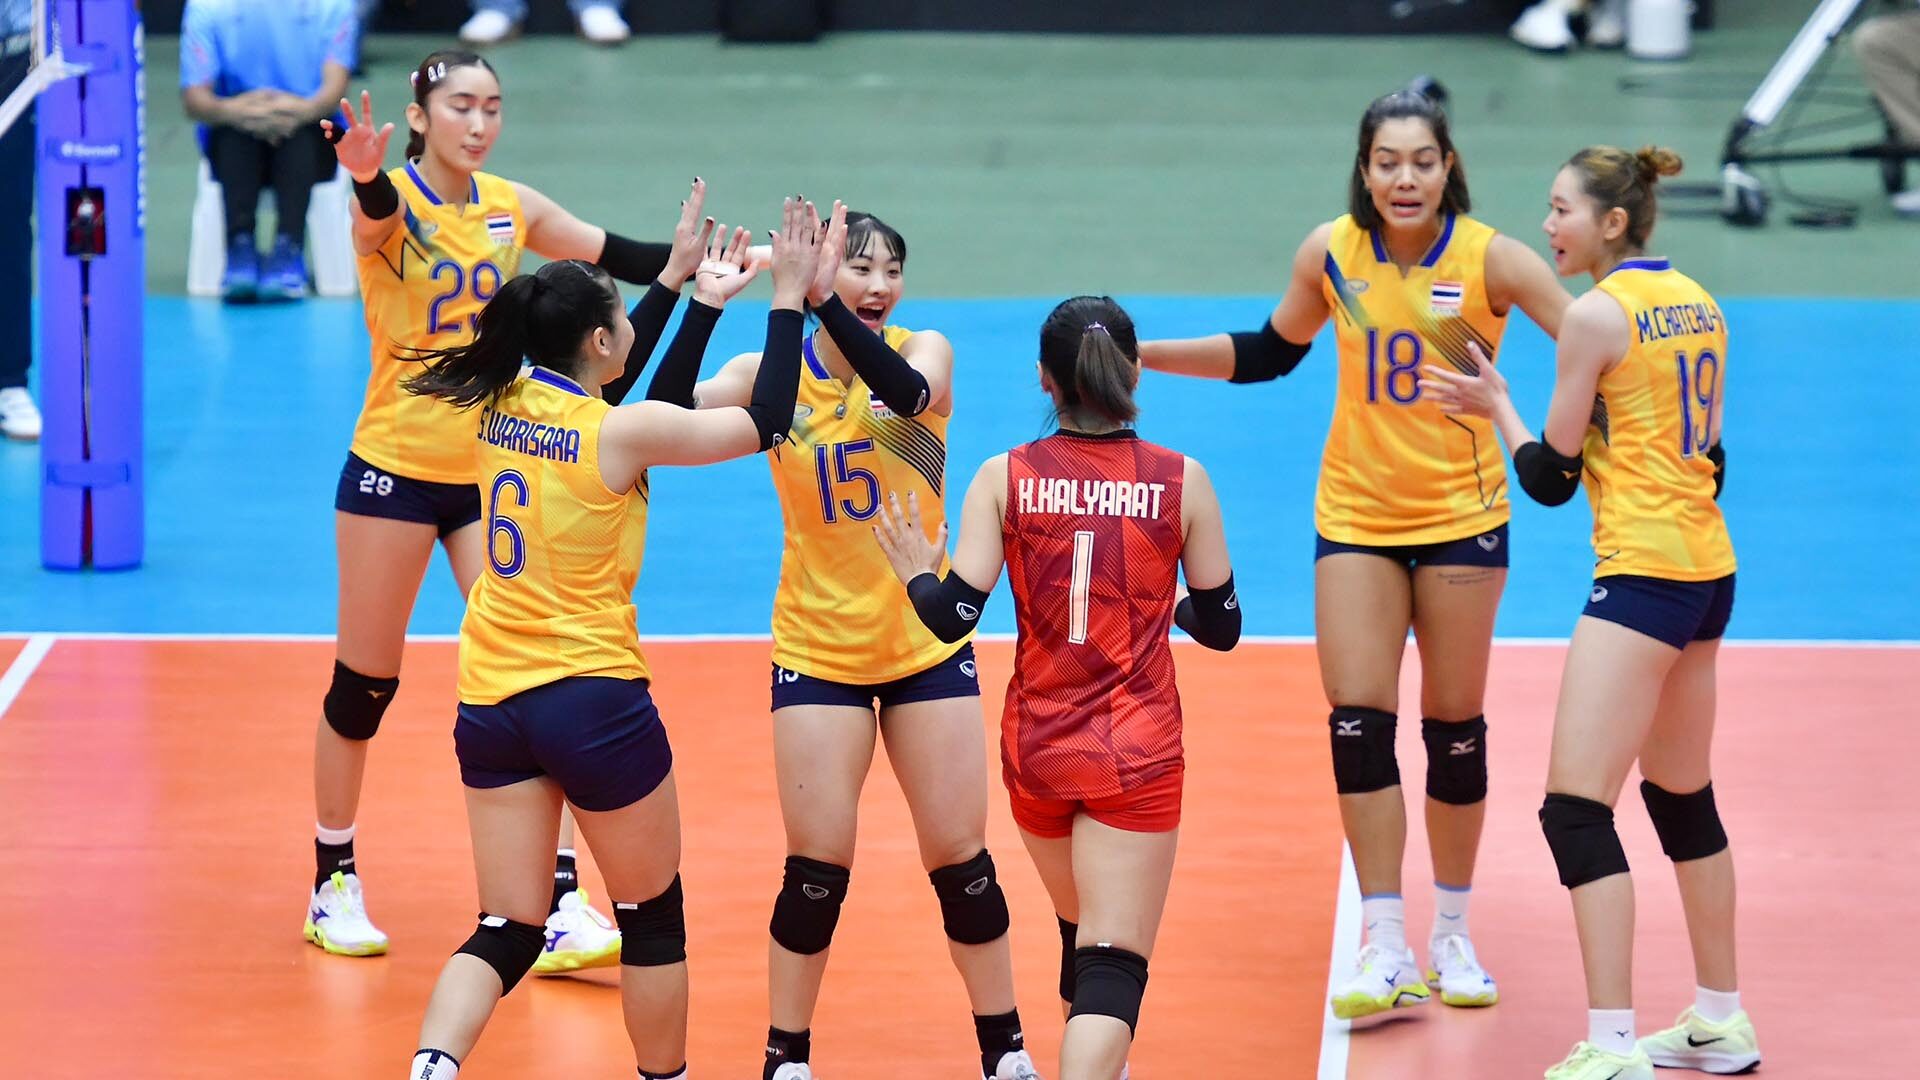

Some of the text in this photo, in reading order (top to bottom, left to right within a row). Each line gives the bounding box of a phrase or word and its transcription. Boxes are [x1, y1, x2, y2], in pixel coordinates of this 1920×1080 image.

[427, 258, 501, 334] 29
[1366, 326, 1423, 405] 18
[1675, 348, 1718, 459] 19
[477, 405, 581, 463] S.WARISARA
[359, 469, 393, 496] 29
[814, 437, 881, 523] 15
[488, 468, 529, 579] 6
[1068, 530, 1095, 645] 1
